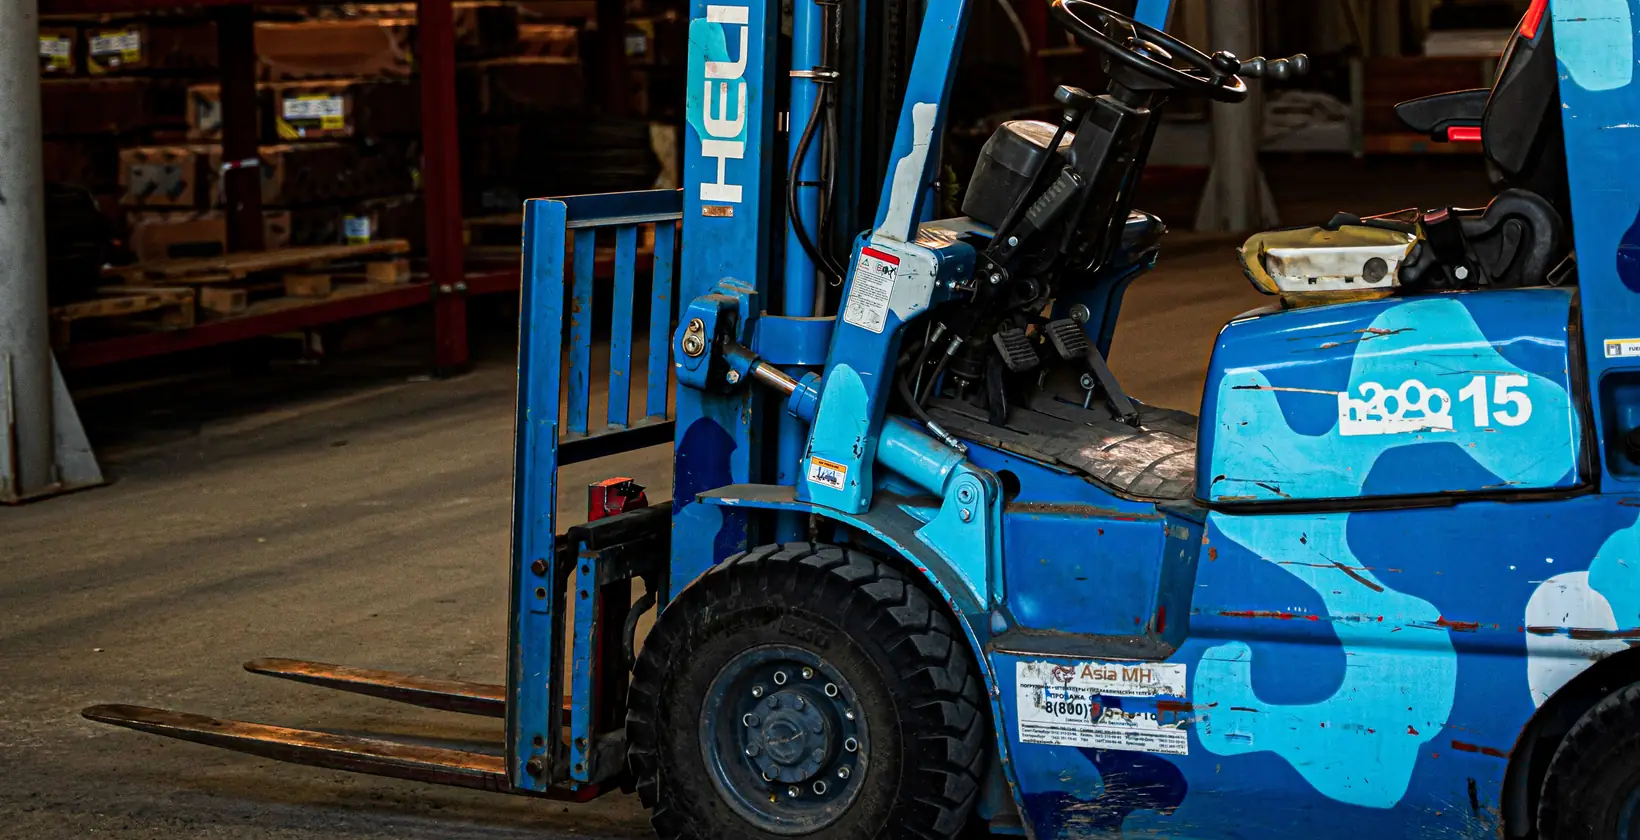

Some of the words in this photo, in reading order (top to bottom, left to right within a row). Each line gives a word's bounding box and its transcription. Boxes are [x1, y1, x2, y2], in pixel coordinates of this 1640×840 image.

[700, 5, 749, 203] HELI
[1458, 374, 1532, 428] 15
[1080, 665, 1117, 681] Asia
[1122, 667, 1151, 683] MH
